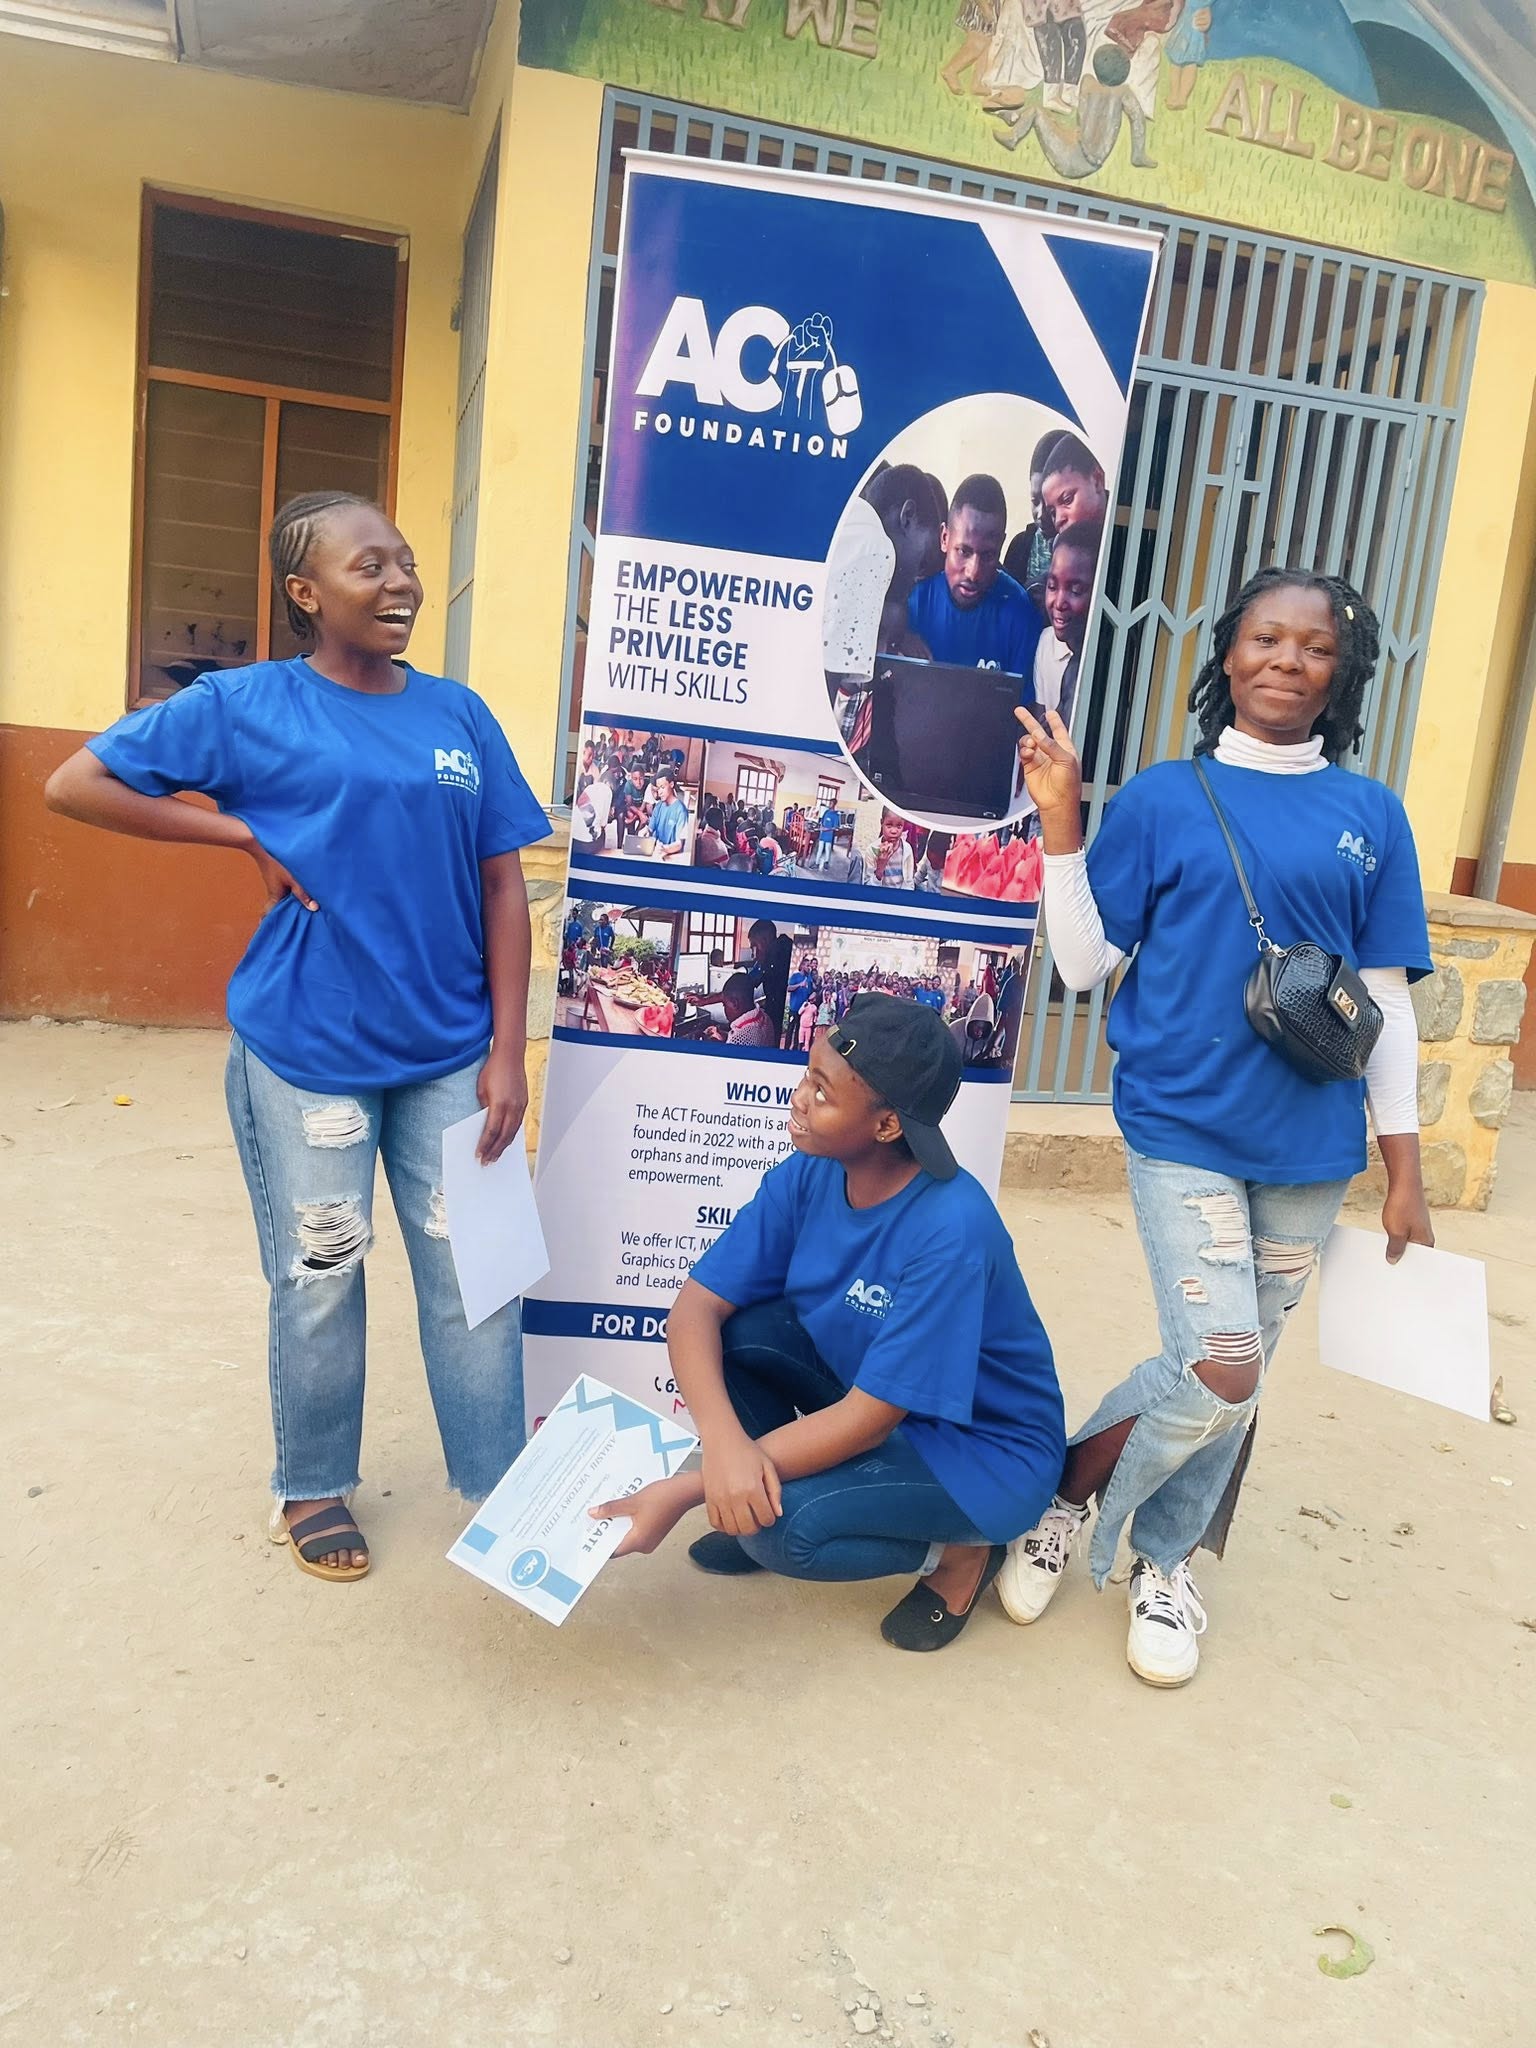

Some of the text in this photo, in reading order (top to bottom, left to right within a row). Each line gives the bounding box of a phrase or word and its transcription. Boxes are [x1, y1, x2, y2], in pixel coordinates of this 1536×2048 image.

[1205, 71, 1514, 214] ALL BE ONE
[634, 411, 848, 459] FOUNDATION
[616, 560, 814, 611] EMPOWERING
[614, 593, 733, 633] THE LESS
[609, 626, 748, 670] PRIVILEGE
[608, 661, 748, 704] WITH SKILLS
[726, 1082, 797, 1105] WHO W
[636, 1104, 658, 1119] The
[662, 1107, 688, 1121] ACT
[690, 1109, 761, 1129] Foundation
[764, 1116, 774, 1130] is
[633, 1124, 686, 1142] founded
[689, 1130, 700, 1144] in
[703, 1132, 734, 1148] 2022
[737, 1134, 764, 1150] with
[767, 1140, 775, 1151] a
[631, 1147, 681, 1163] orphans
[685, 1151, 708, 1165] and
[628, 1168, 724, 1187] empowerment.
[696, 1205, 740, 1226] SKIL
[621, 1231, 640, 1246] We
[643, 1233, 672, 1248] offer
[675, 1235, 697, 1251] ICT,
[621, 1252, 675, 1269] Graphics
[616, 1273, 685, 1290] and Leade
[591, 1313, 636, 1336] FOR
[560, 1473, 591, 1512] VICTORY
